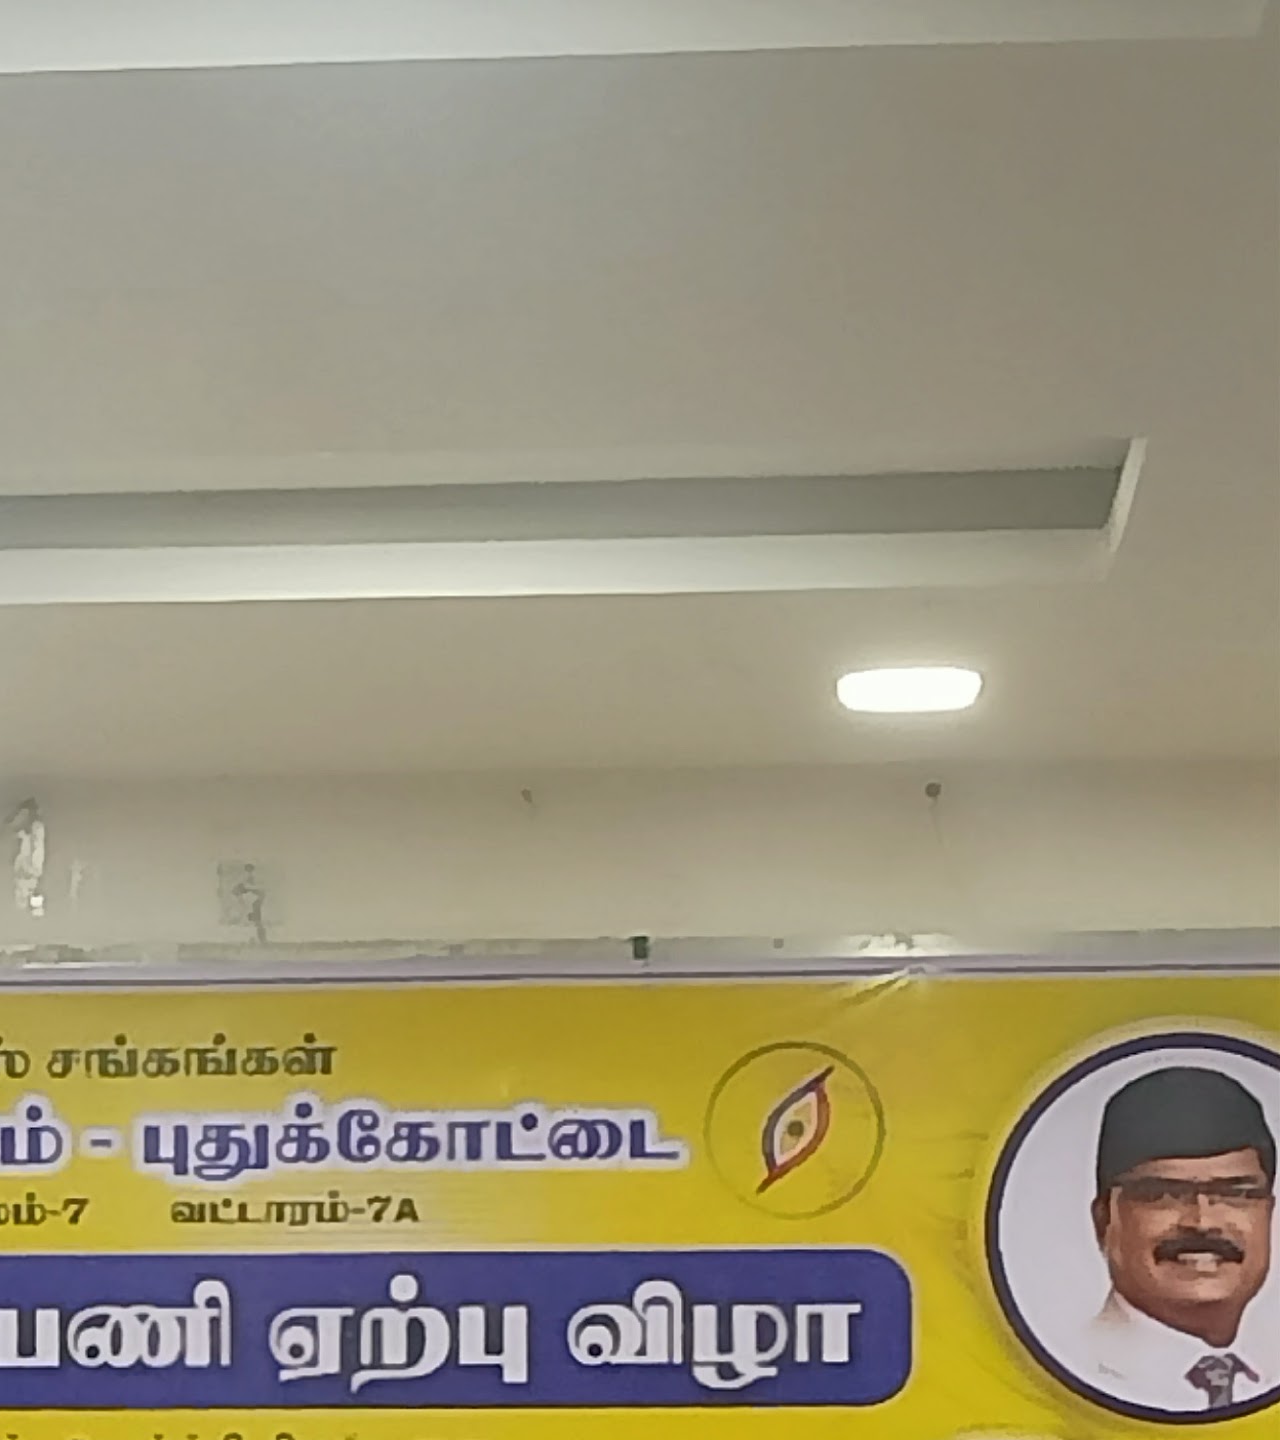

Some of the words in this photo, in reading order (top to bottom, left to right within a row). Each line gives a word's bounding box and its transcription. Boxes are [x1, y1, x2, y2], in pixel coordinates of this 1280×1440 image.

[46, 1034, 337, 1080] சங்கங்கள்
[142, 1103, 680, 1178] புதுக்கோட்டை
[170, 1192, 420, 1228] வட்டாரம்-7A
[269, 1272, 531, 1391] ஏற்பு
[567, 1281, 863, 1389] விழா
